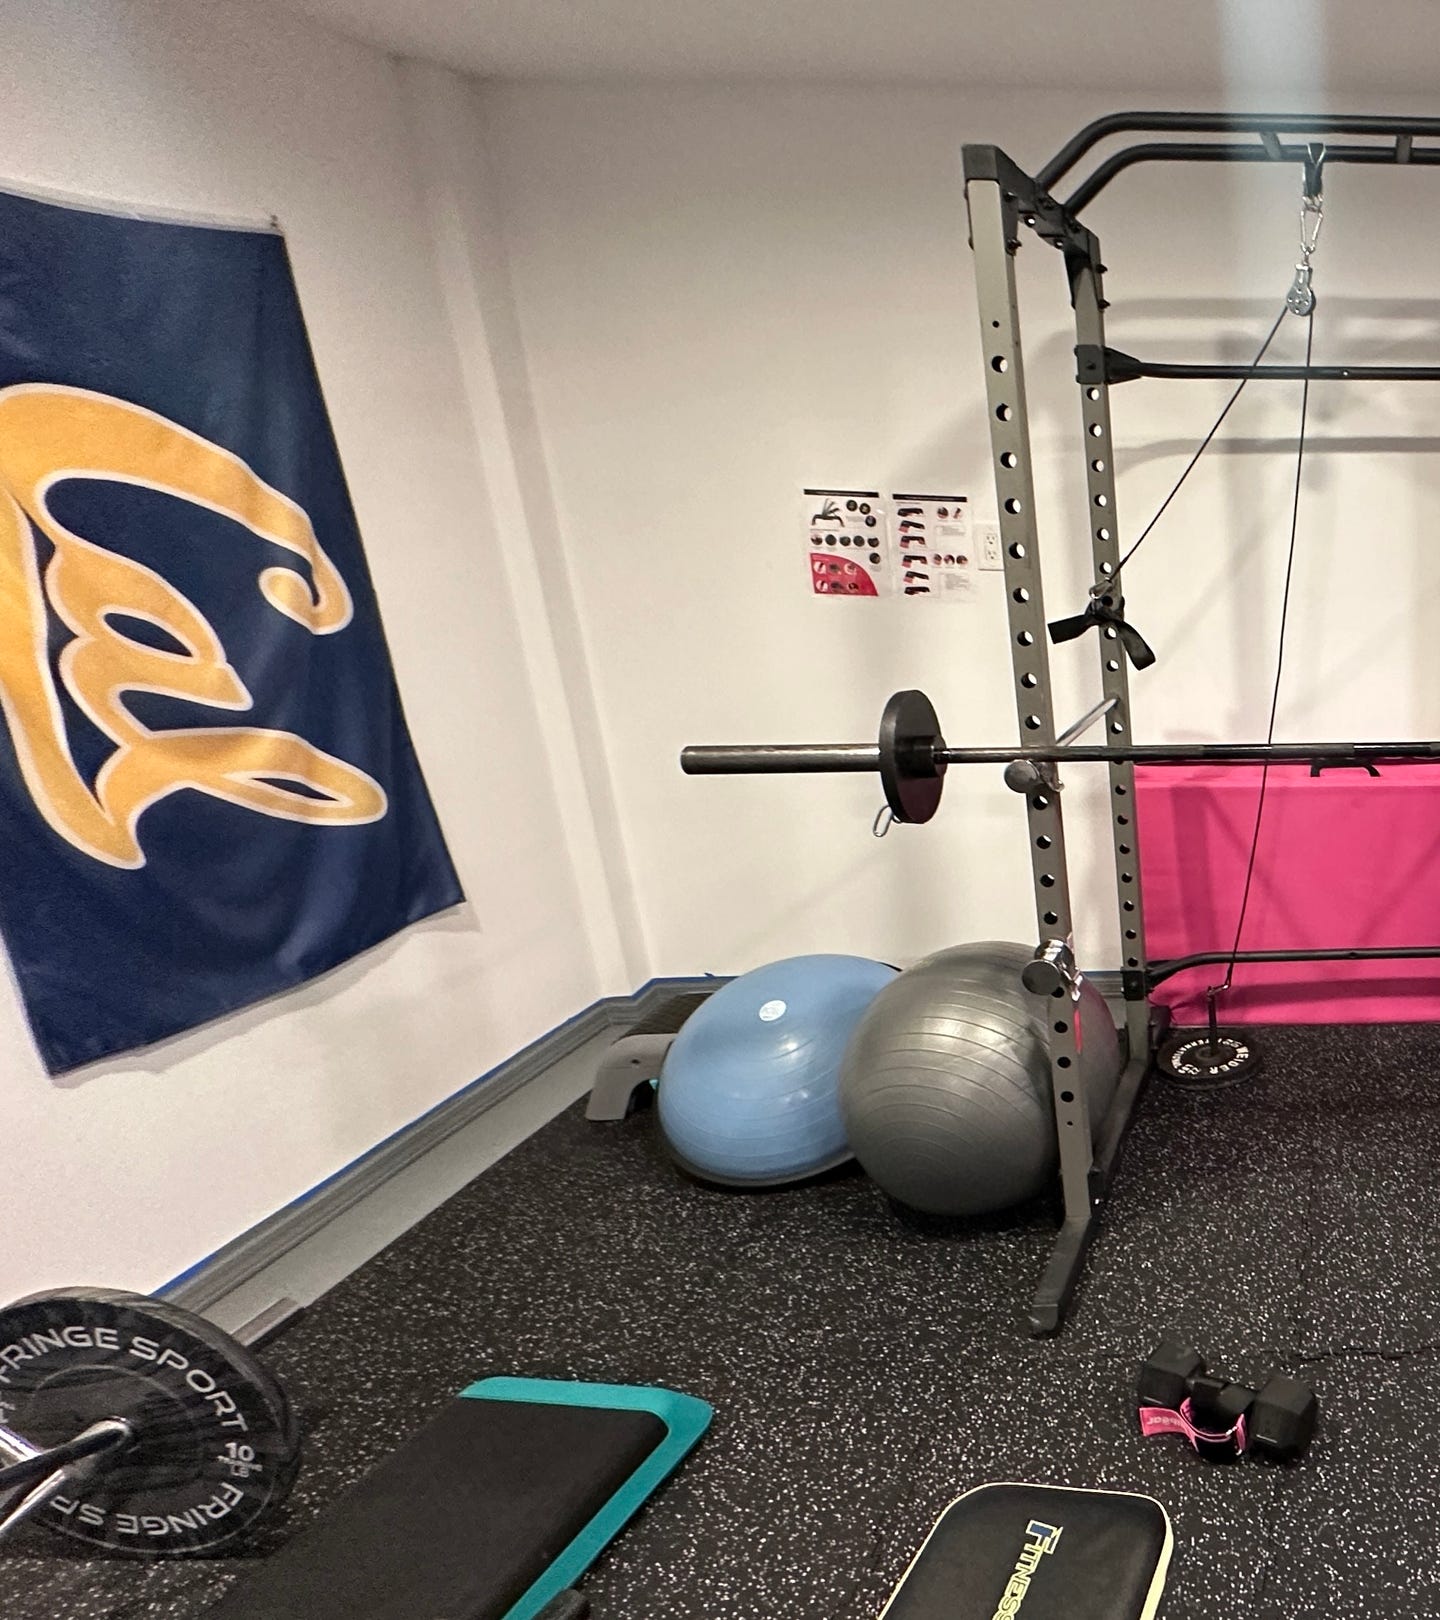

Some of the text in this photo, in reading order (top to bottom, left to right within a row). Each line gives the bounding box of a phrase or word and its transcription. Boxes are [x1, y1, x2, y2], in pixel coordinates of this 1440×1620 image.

[0, 383, 389, 870] Cal
[129, 1336, 248, 1431] SPORT
[225, 1442, 255, 1462] 10
[116, 1482, 244, 1535] FRINGE
